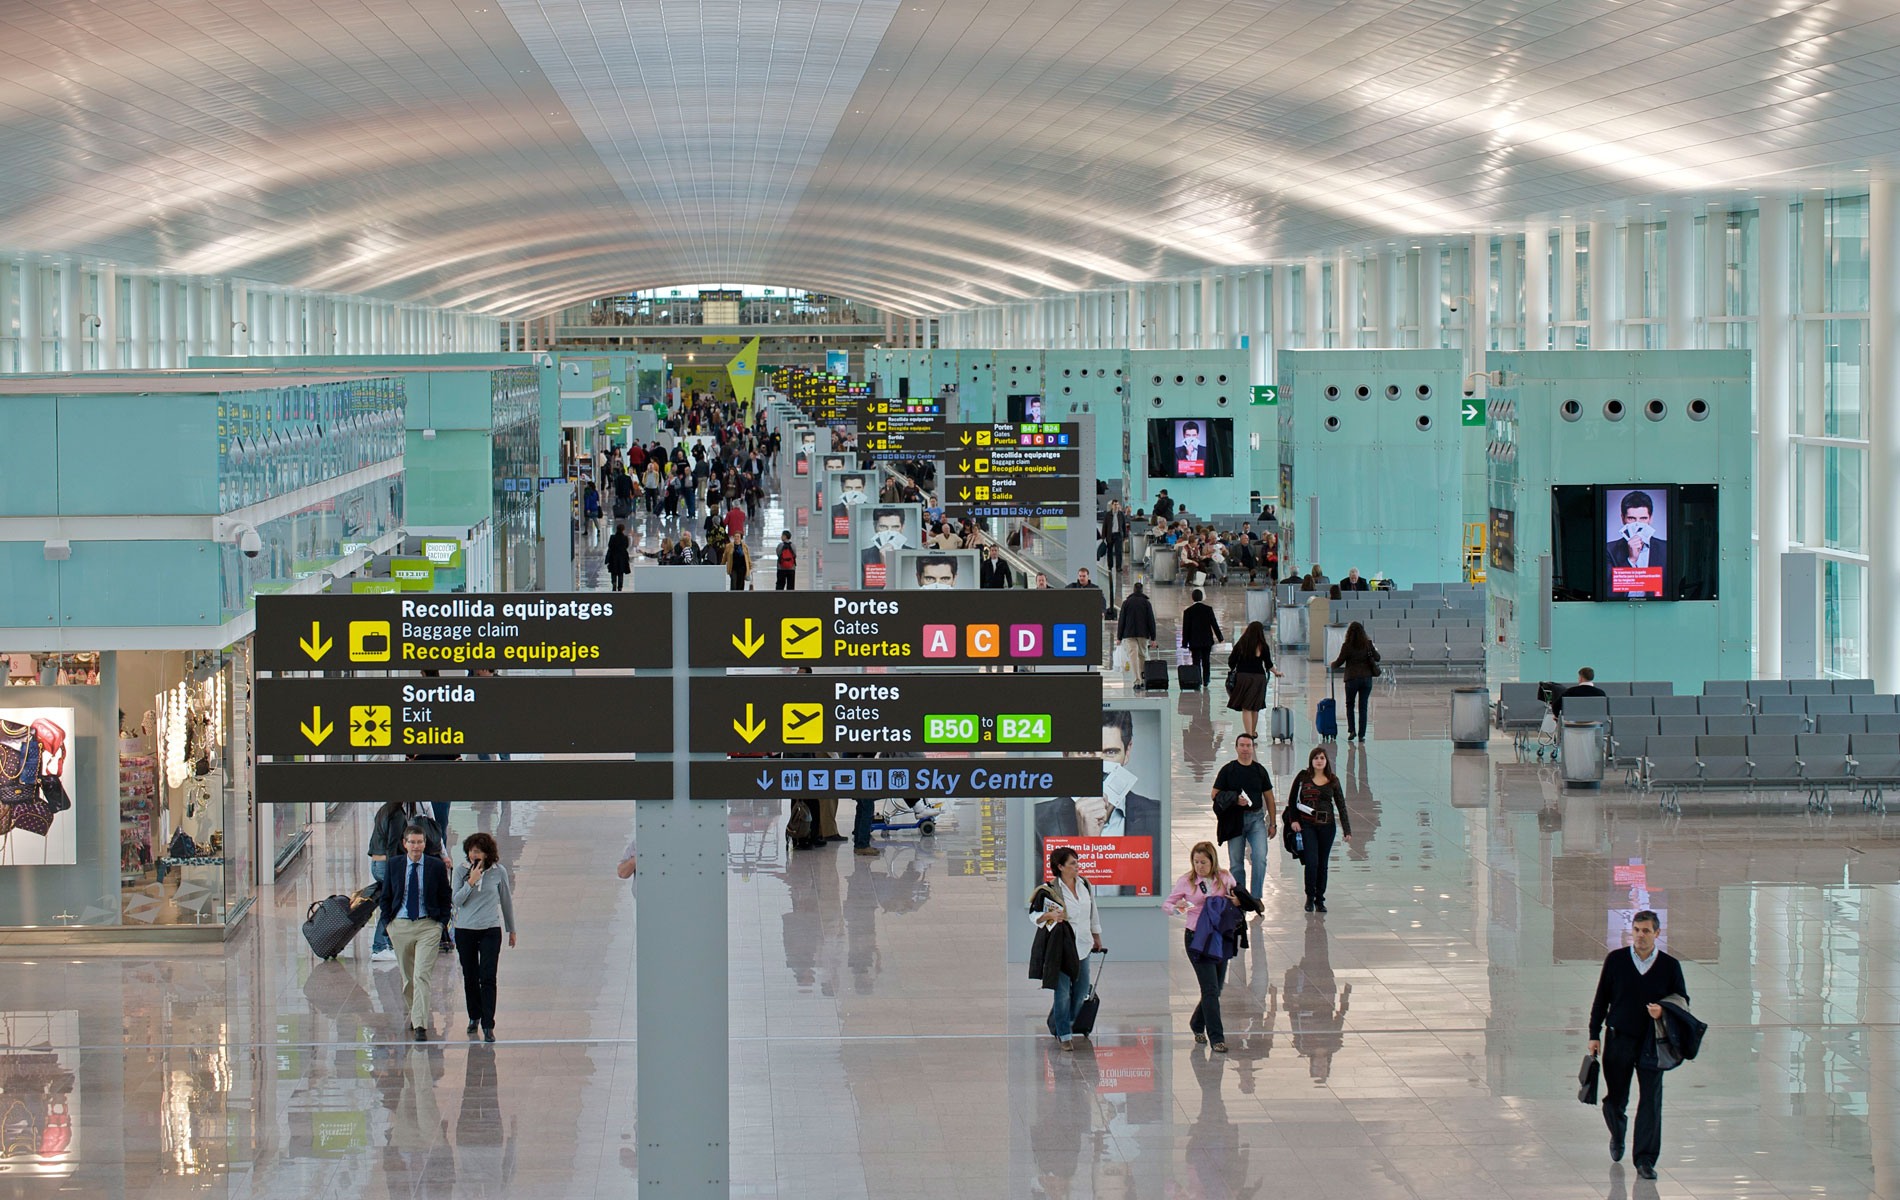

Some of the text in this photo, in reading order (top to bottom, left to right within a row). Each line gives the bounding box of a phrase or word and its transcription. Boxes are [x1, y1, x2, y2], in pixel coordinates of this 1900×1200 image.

[1018, 508, 1033, 516] Sky
[401, 599, 613, 621] Recollida equipatges
[834, 597, 899, 615] Portes
[402, 621, 519, 640] Baggage claim
[833, 618, 879, 635] Gates
[834, 639, 911, 657] Puertas
[930, 630, 1077, 652] A C D E
[402, 641, 600, 663] Recogida equipajes
[402, 684, 475, 703] Sortida
[834, 682, 900, 701] Portes
[402, 706, 432, 723] Exit
[834, 704, 880, 721] Gates
[402, 726, 465, 745] Salida
[835, 724, 912, 742] Puertas
[930, 716, 1046, 739] B50 to B24
[984, 730, 992, 741] a
[914, 767, 1054, 795] Sky Centre
[1092, 843, 1115, 852] jugada
[1079, 861, 1097, 870] egoci
